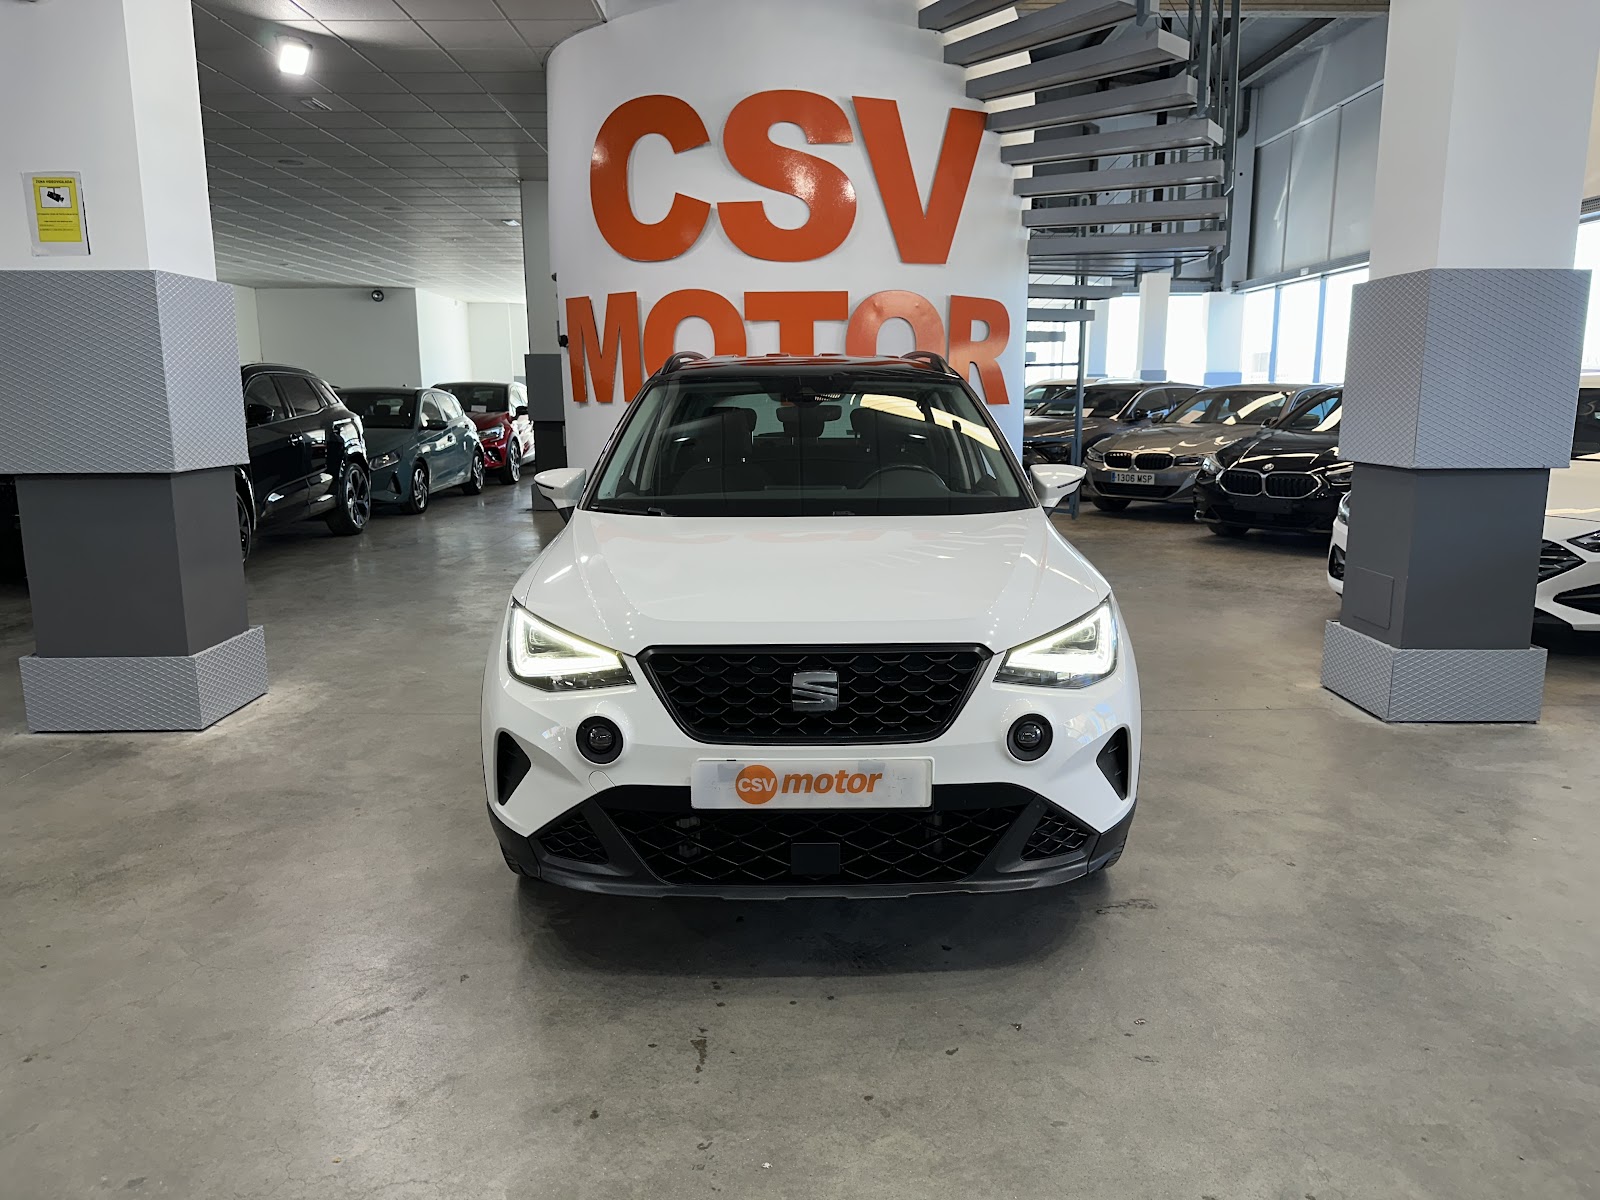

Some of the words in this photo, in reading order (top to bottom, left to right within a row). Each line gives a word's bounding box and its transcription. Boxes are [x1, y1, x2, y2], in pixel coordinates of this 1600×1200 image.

[590, 90, 988, 264] CSV
[566, 289, 1011, 405] MOTOR
[1117, 473, 1135, 483] 1306
[1137, 474, 1152, 483] MSP
[738, 777, 776, 792] CSV
[781, 770, 883, 794] motor
